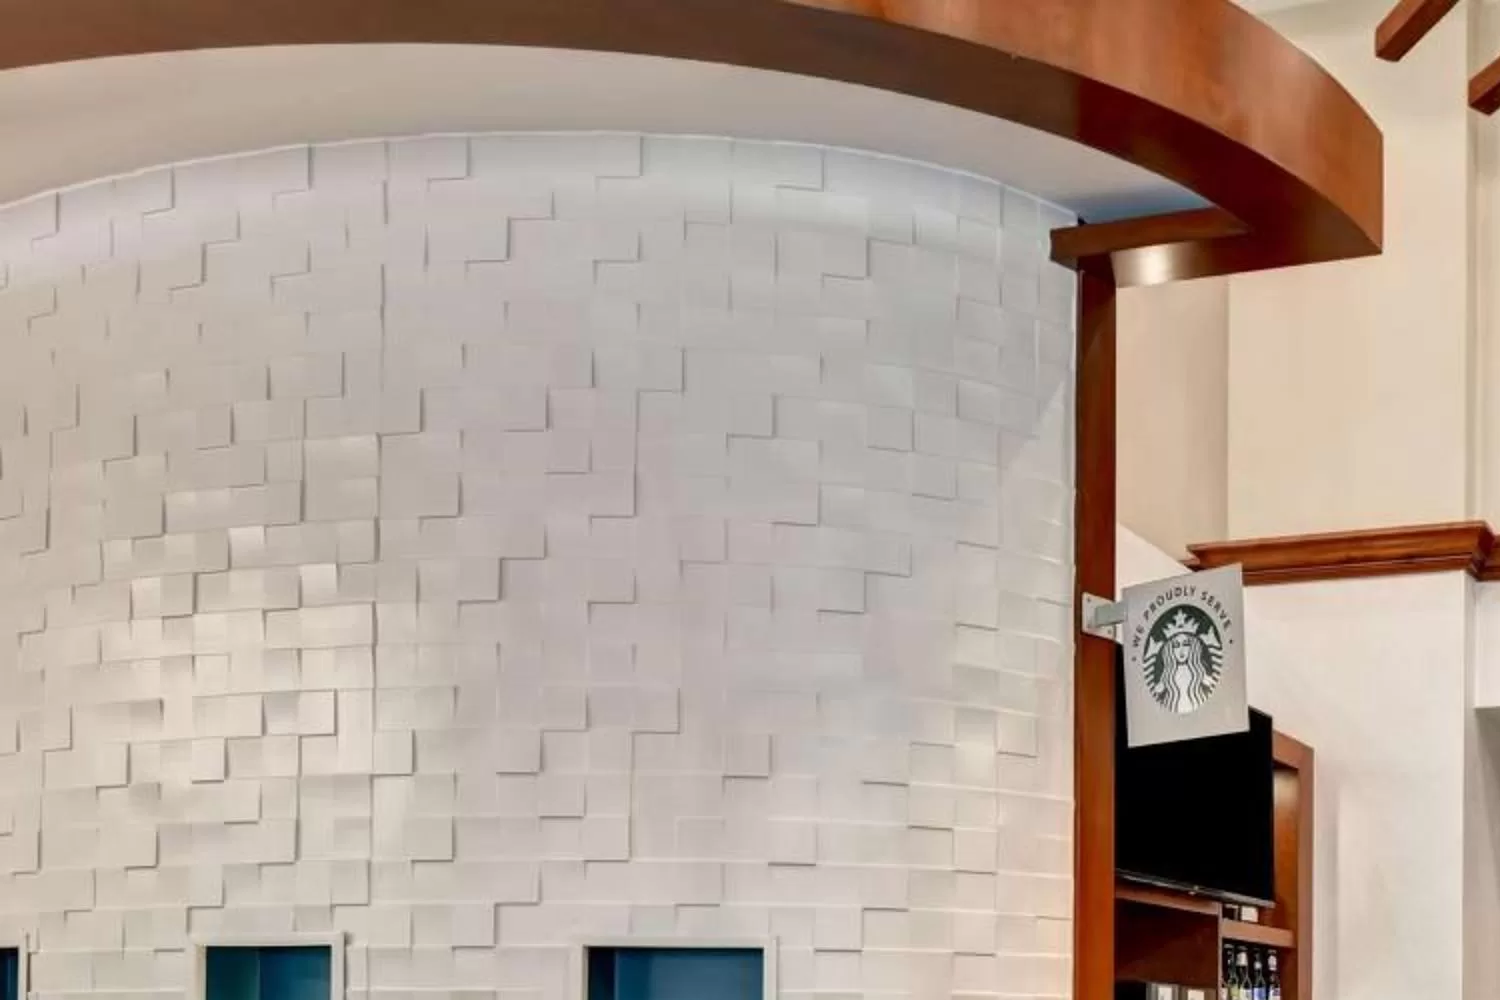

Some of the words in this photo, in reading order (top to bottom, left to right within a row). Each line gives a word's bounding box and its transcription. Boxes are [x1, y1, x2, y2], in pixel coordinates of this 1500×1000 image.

[1132, 624, 1145, 648] WE
[1143, 585, 1197, 620] PROUDLY
[1200, 591, 1232, 630] SERVE
